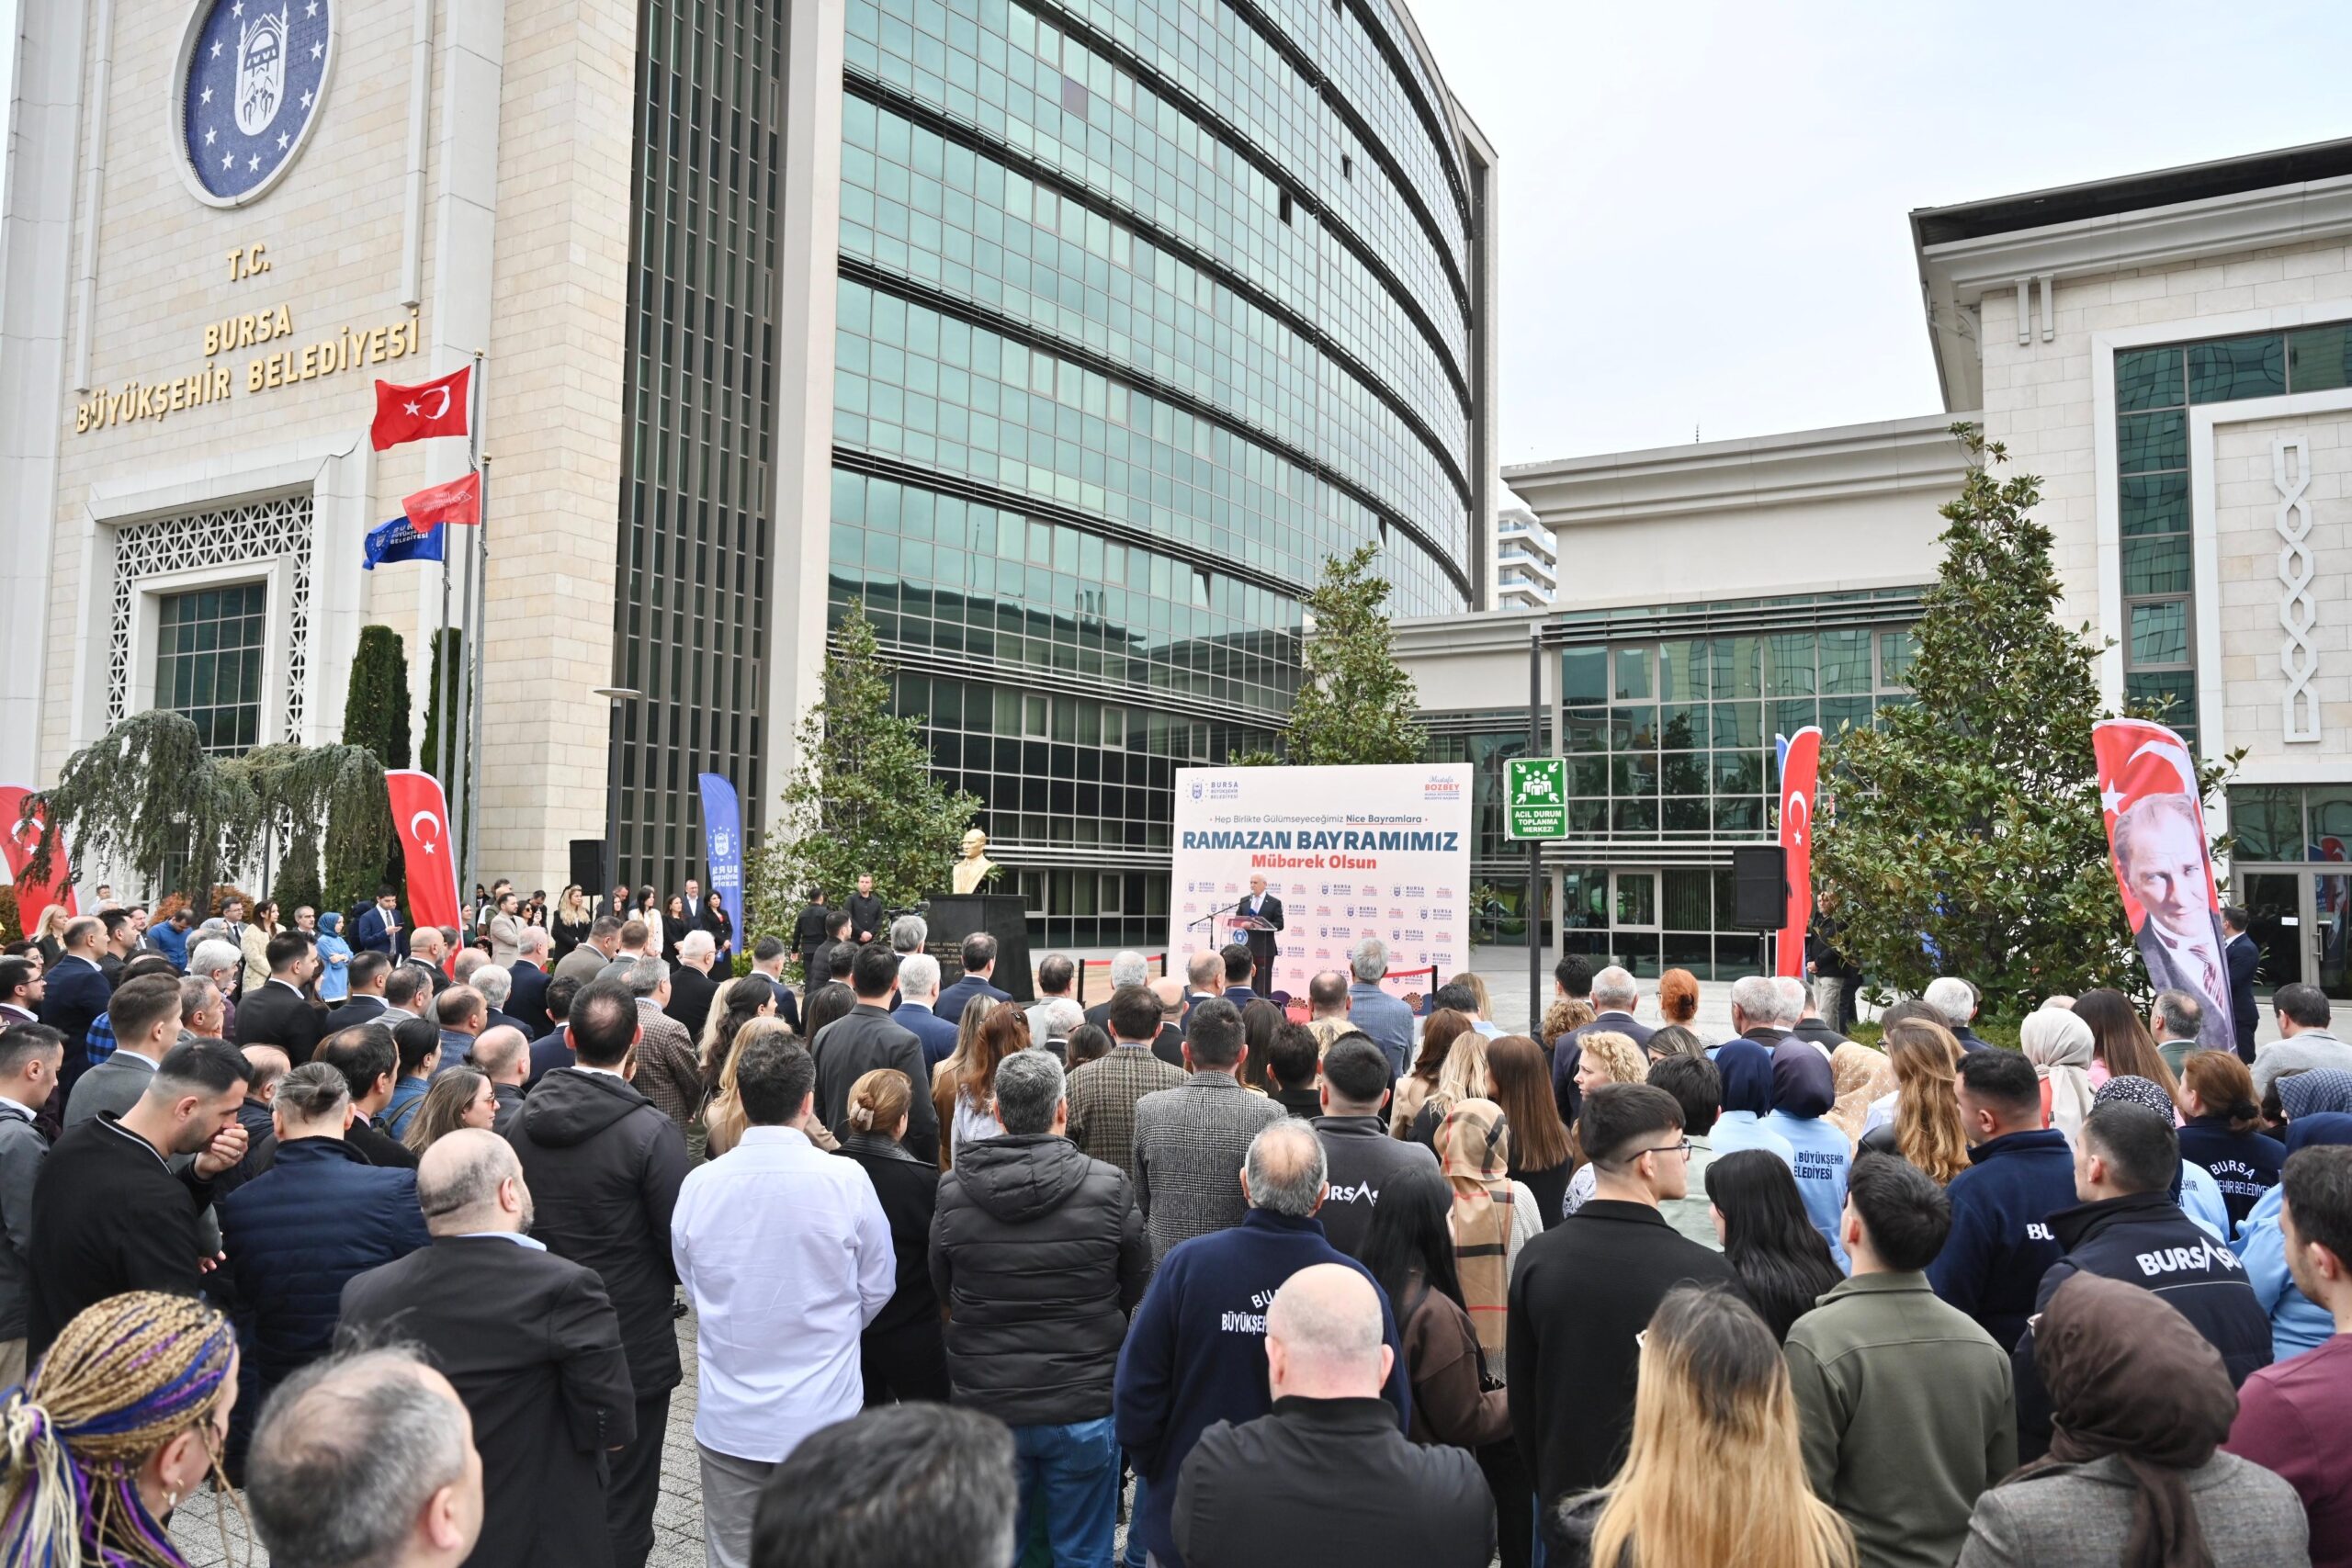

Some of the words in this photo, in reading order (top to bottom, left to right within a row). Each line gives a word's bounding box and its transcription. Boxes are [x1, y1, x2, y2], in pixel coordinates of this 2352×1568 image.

[227, 243, 271, 281] T.C.
[203, 304, 293, 356] BURSA
[75, 361, 232, 434] BÜYÜKŞEHİR
[247, 309, 420, 393] BELEDİYESİ
[1215, 816, 1231, 824] Hep
[1233, 815, 1261, 823] Birlikte
[1263, 814, 1344, 825] Gülümseyeceğimiz
[1346, 815, 1365, 823] Nice
[1368, 815, 1422, 825] Bayramlara
[1182, 830, 1292, 850] RAMAZAN
[1297, 830, 1459, 852] BAYRAMIMIZ
[1251, 853, 1325, 868] Mübarek
[1329, 854, 1377, 869] Olsun
[1798, 1150, 1843, 1167] BÜYÜKŞEHİR
[1794, 1165, 1832, 1179] ELEDİYESİ
[2210, 1160, 2256, 1179] BURSA
